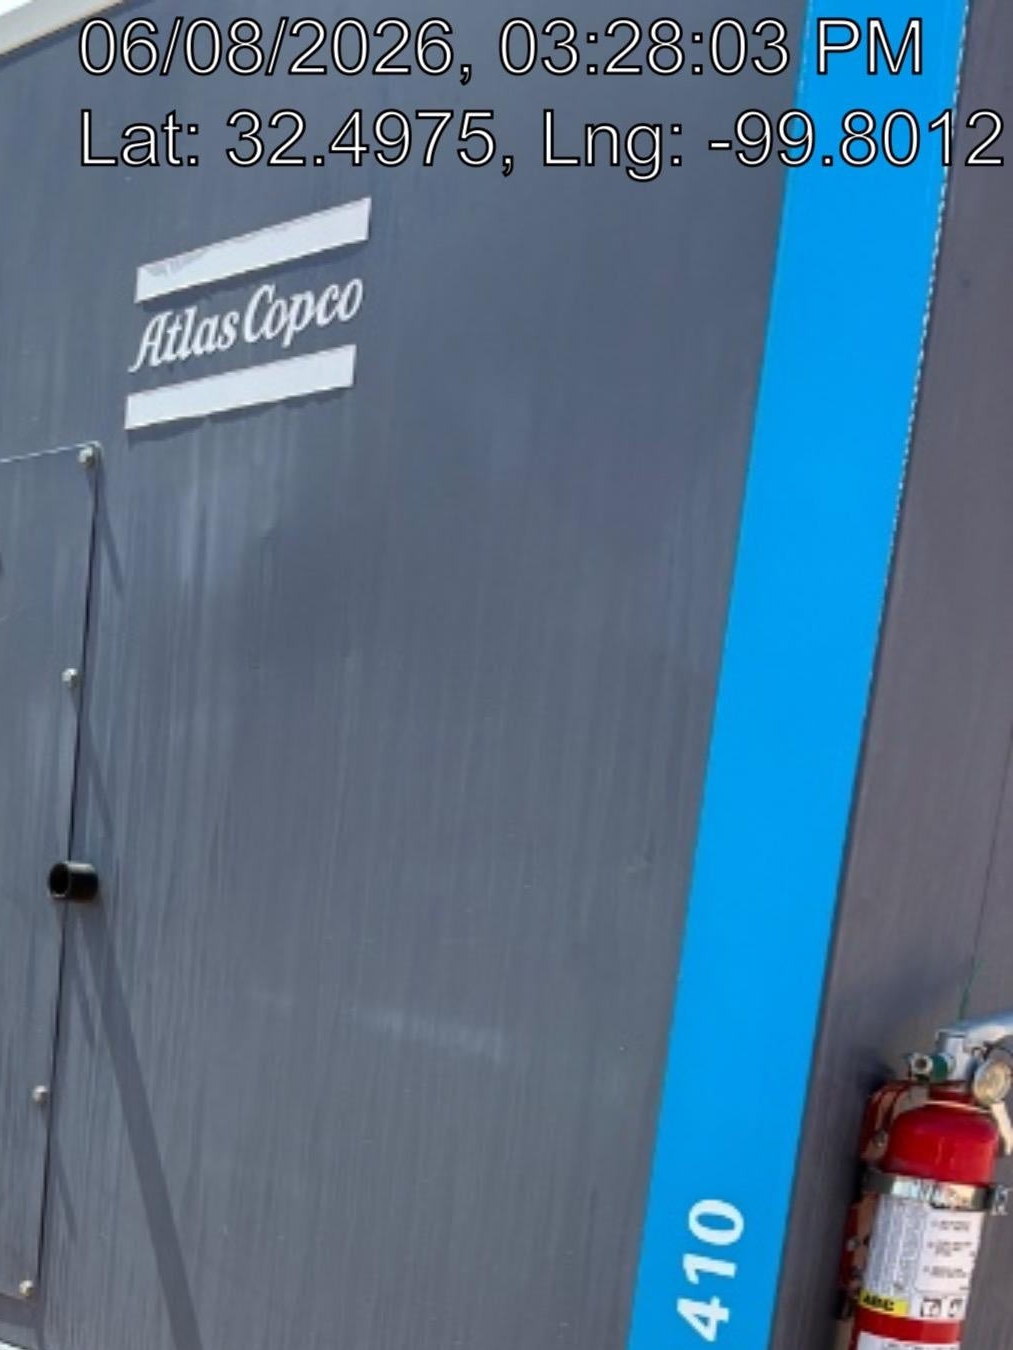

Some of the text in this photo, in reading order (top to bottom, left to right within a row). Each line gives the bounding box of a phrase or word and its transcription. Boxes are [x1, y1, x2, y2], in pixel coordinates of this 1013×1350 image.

[127, 278, 363, 373] Atlas Copco
[676, 1199, 744, 1342] 410
